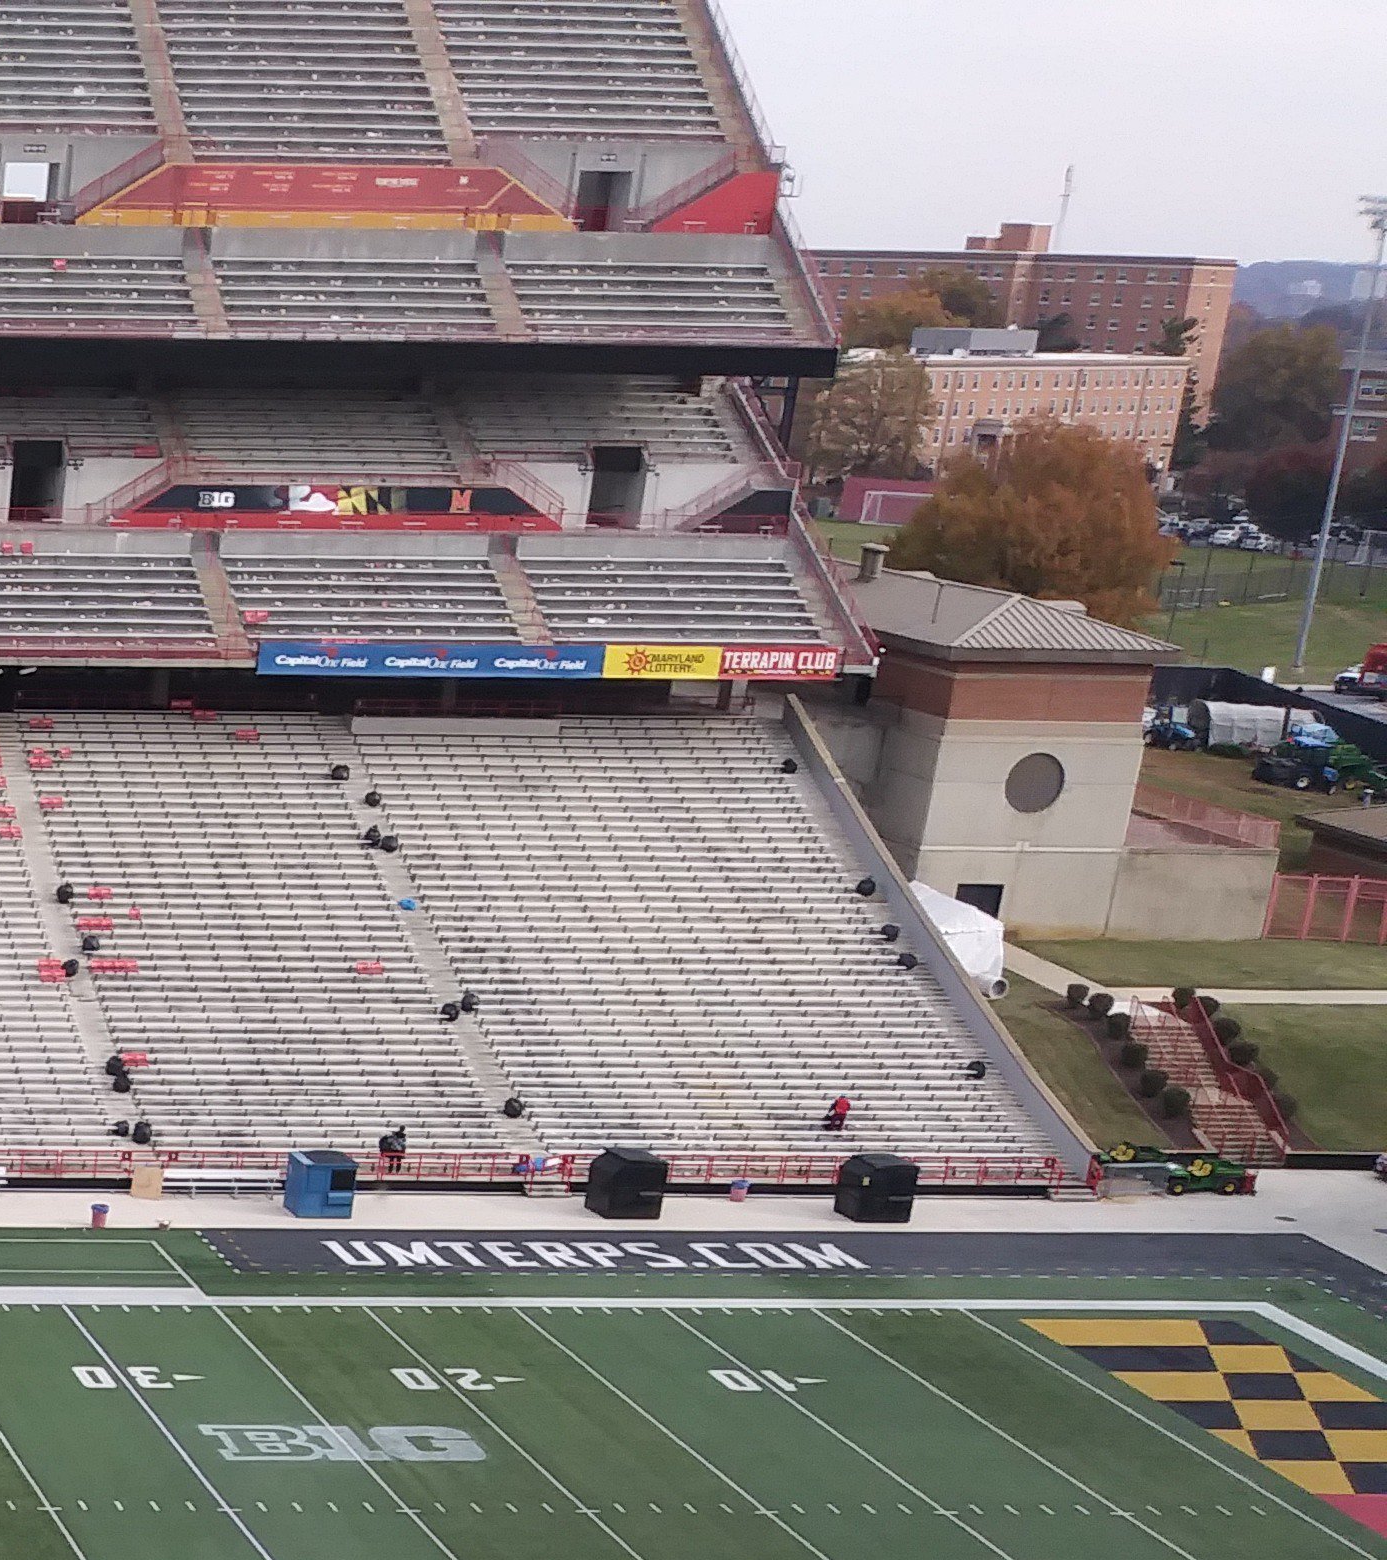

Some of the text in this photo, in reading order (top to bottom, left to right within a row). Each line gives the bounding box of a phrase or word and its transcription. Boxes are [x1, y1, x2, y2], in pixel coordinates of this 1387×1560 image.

[340, 655, 368, 668] Field
[450, 656, 478, 670] Field
[559, 657, 587, 671] Field
[650, 653, 705, 664] MARYLAND
[723, 650, 837, 671] TERRAPIN CLUB
[320, 1239, 872, 1270] UMTERPS.COM
